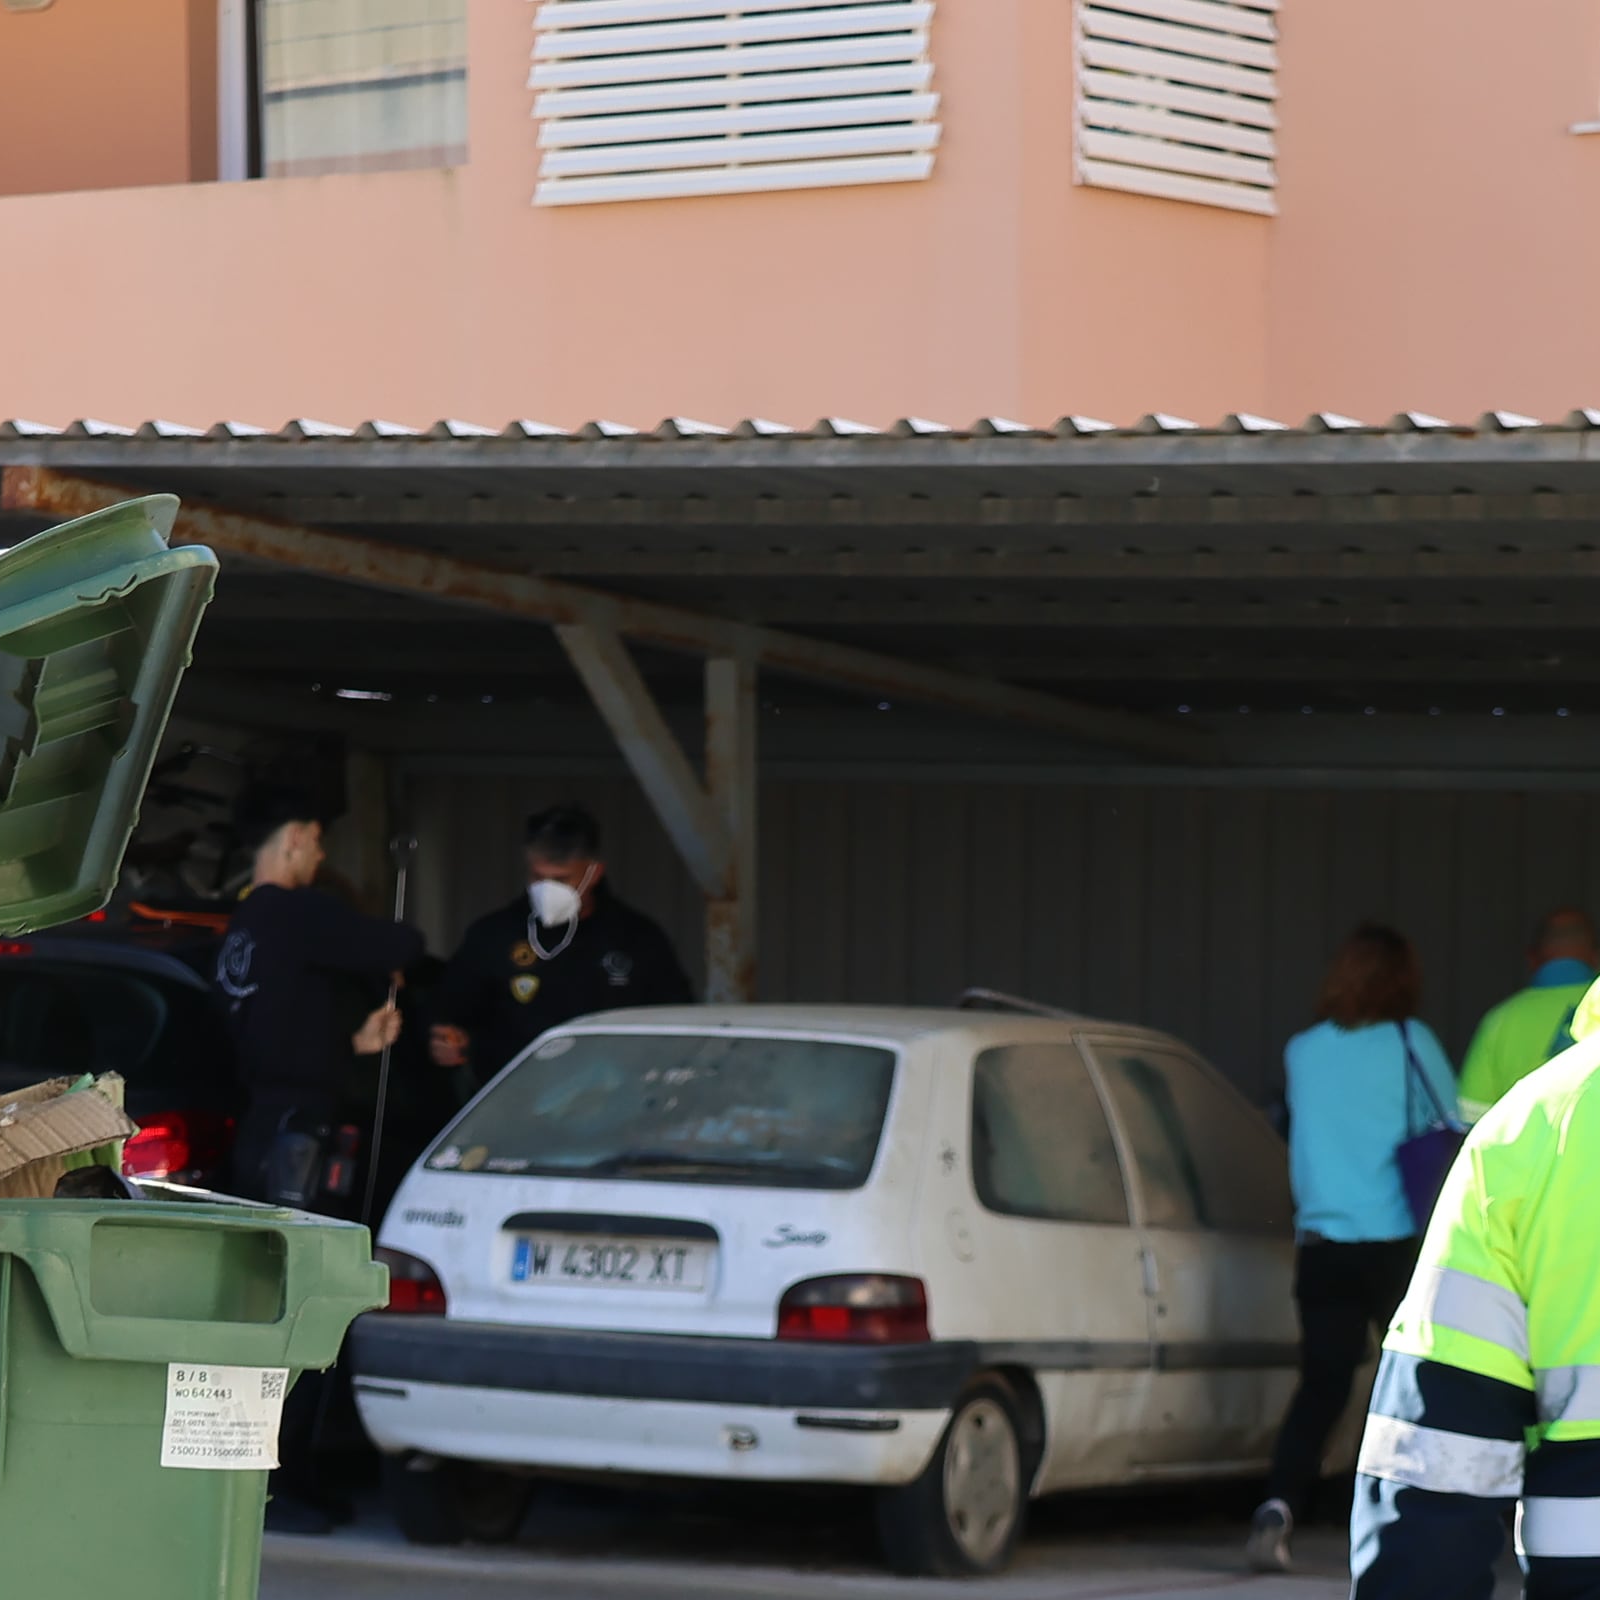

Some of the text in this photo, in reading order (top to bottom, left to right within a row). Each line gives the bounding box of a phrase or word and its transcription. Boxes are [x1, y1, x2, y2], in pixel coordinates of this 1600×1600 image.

[561, 1244, 640, 1281] 4302
[176, 1370, 185, 1382] 8
[198, 1371, 207, 1383] 8
